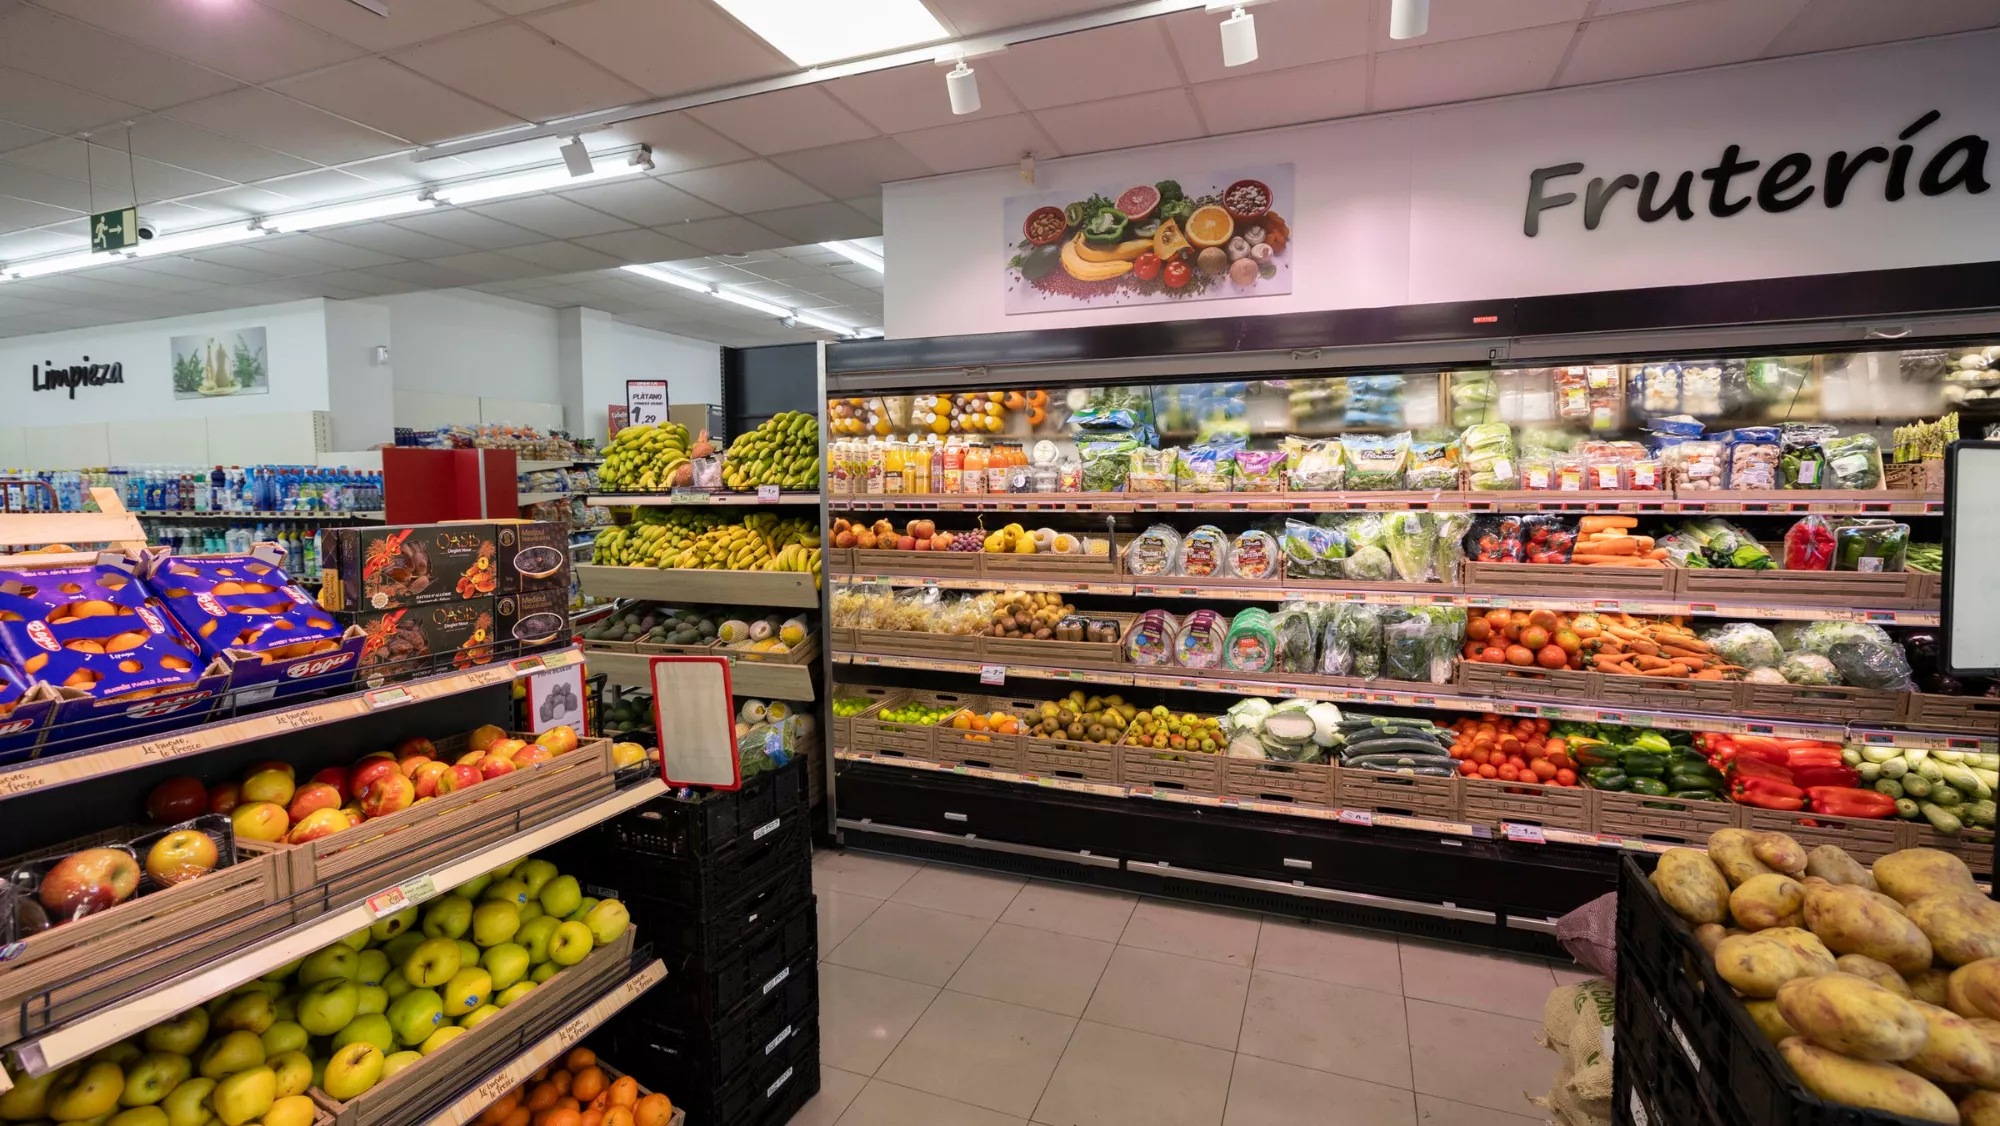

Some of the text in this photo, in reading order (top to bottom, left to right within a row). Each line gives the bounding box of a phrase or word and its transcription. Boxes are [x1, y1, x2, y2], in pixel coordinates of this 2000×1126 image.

[1523, 109, 1991, 238] Frutería
[32, 355, 124, 399] Limpieza
[631, 406, 656, 424] 1,29
[436, 531, 481, 550] OASIS
[198, 594, 228, 616] Bagu
[432, 606, 478, 625] OASIS
[28, 620, 60, 650] Bagu
[288, 652, 354, 678] Bagu
[0, 774, 30, 788] ueno,
